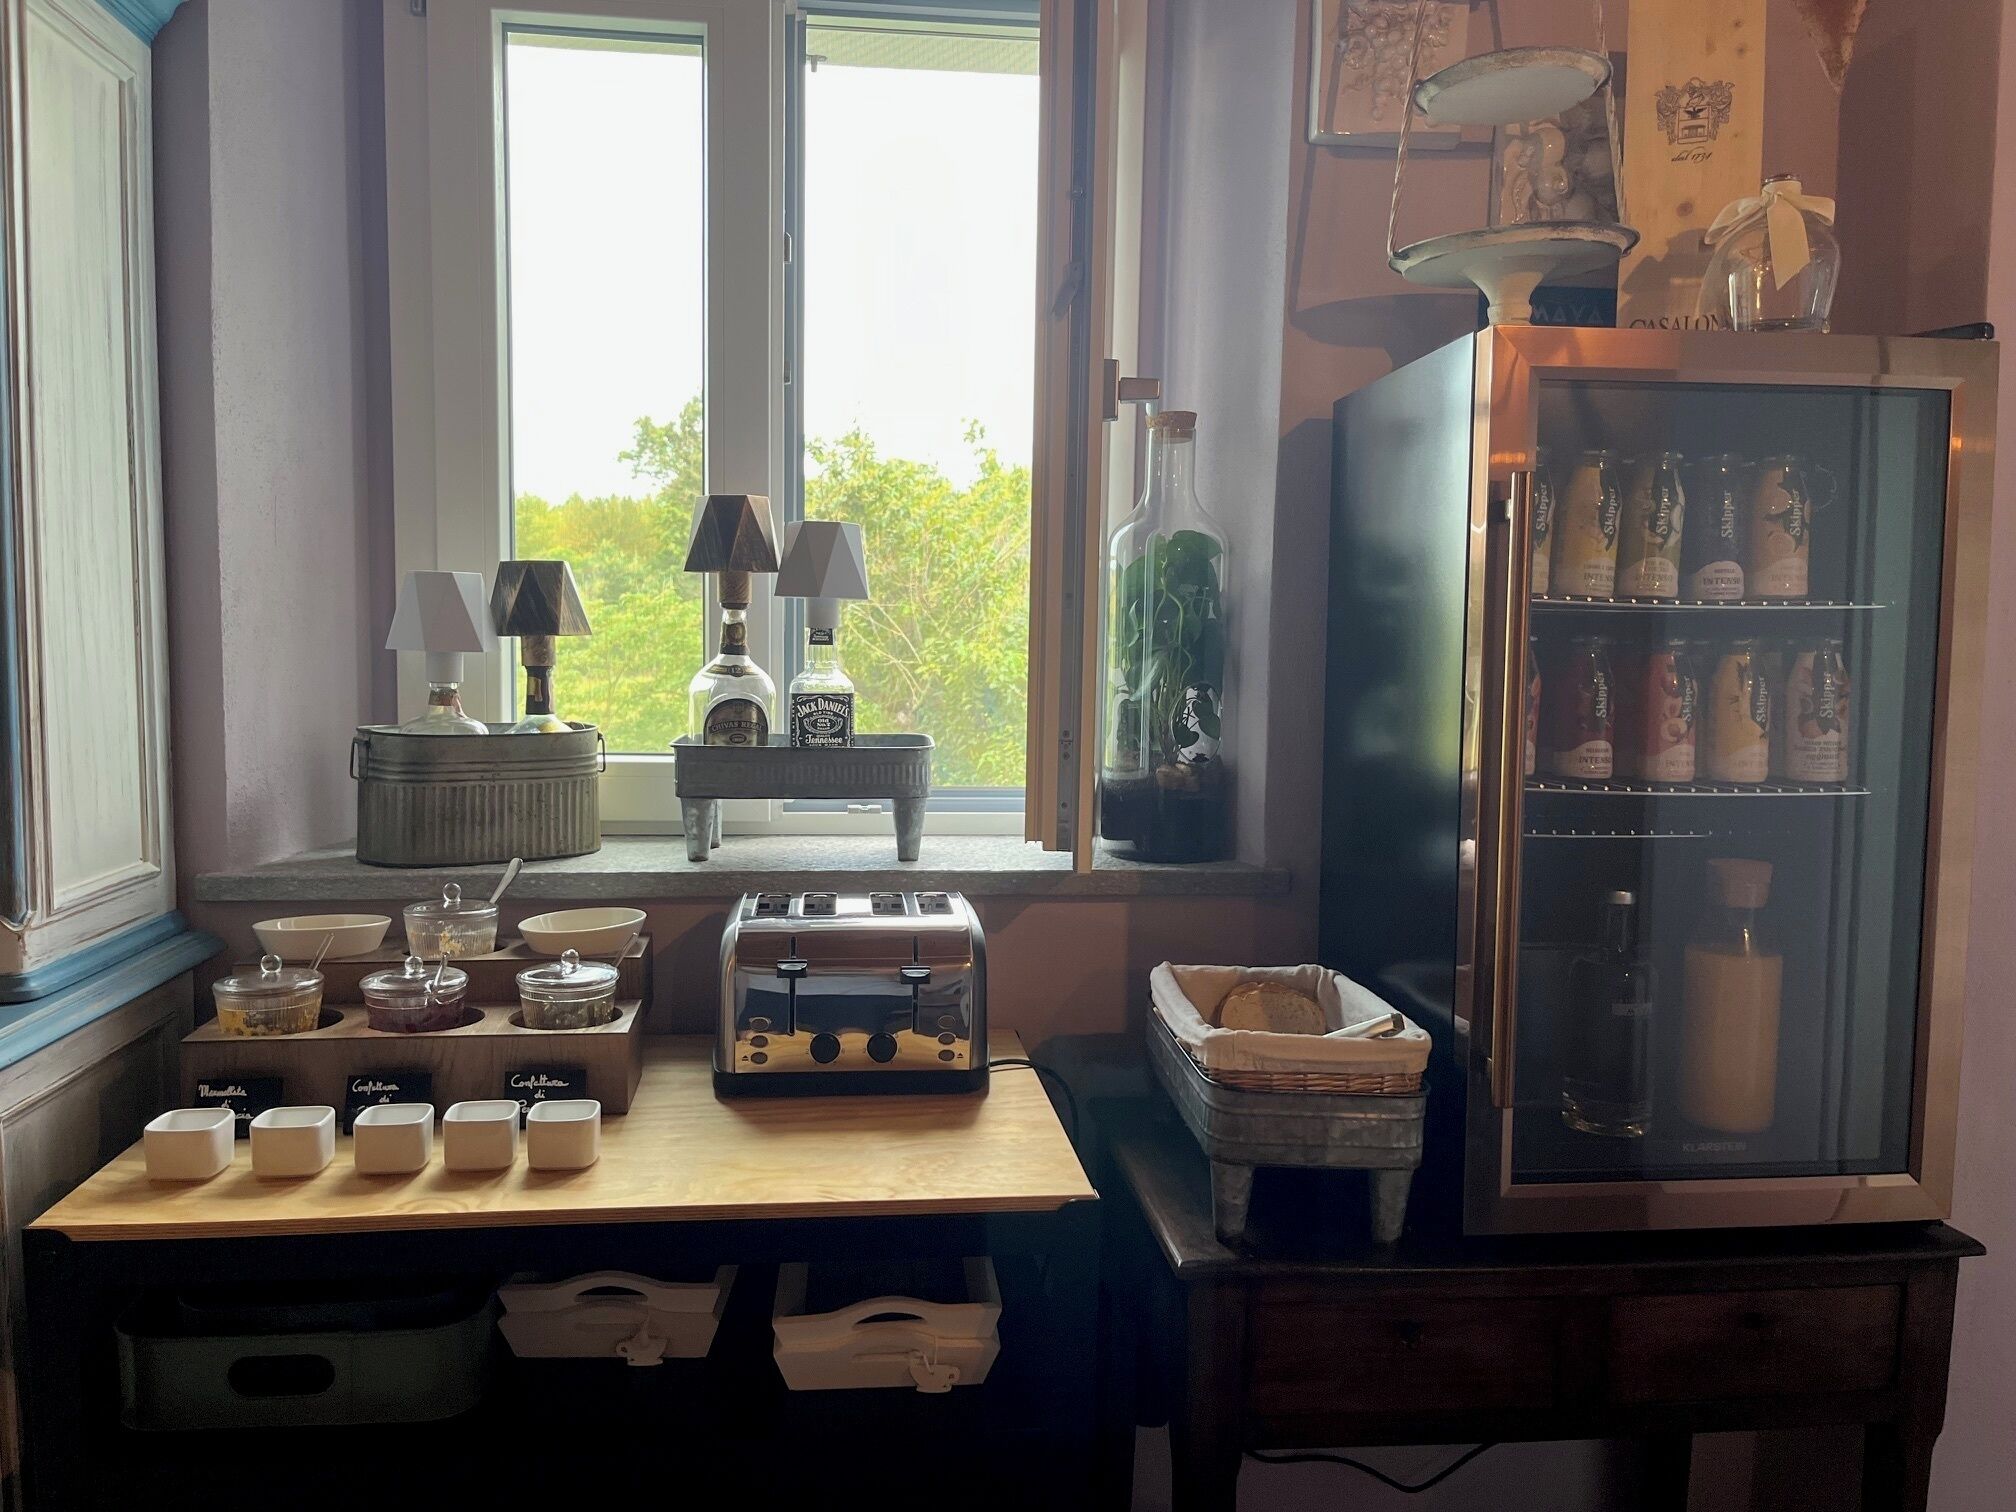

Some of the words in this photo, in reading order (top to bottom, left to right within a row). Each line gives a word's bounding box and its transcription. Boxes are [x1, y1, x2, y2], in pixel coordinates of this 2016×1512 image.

[1536, 483, 1549, 532] Skipper
[1604, 487, 1618, 535] Skipper
[1656, 486, 1671, 535] Skipper
[1721, 490, 1735, 538] Skipper
[1790, 488, 1803, 536] Skipper
[797, 701, 818, 718] JACK
[818, 697, 850, 718] DANIEL'S
[1595, 670, 1608, 718] Skipper
[1682, 675, 1694, 722] Skipper
[1756, 676, 1768, 723] Skipper
[1820, 671, 1835, 719] Skipper
[711, 721, 739, 732] CHIVAS
[741, 721, 762, 731] REGAL
[805, 734, 843, 744] Tennessee
[379, 1094, 392, 1103] di
[510, 1074, 570, 1089] Confettura
[534, 1089, 546, 1099] di
